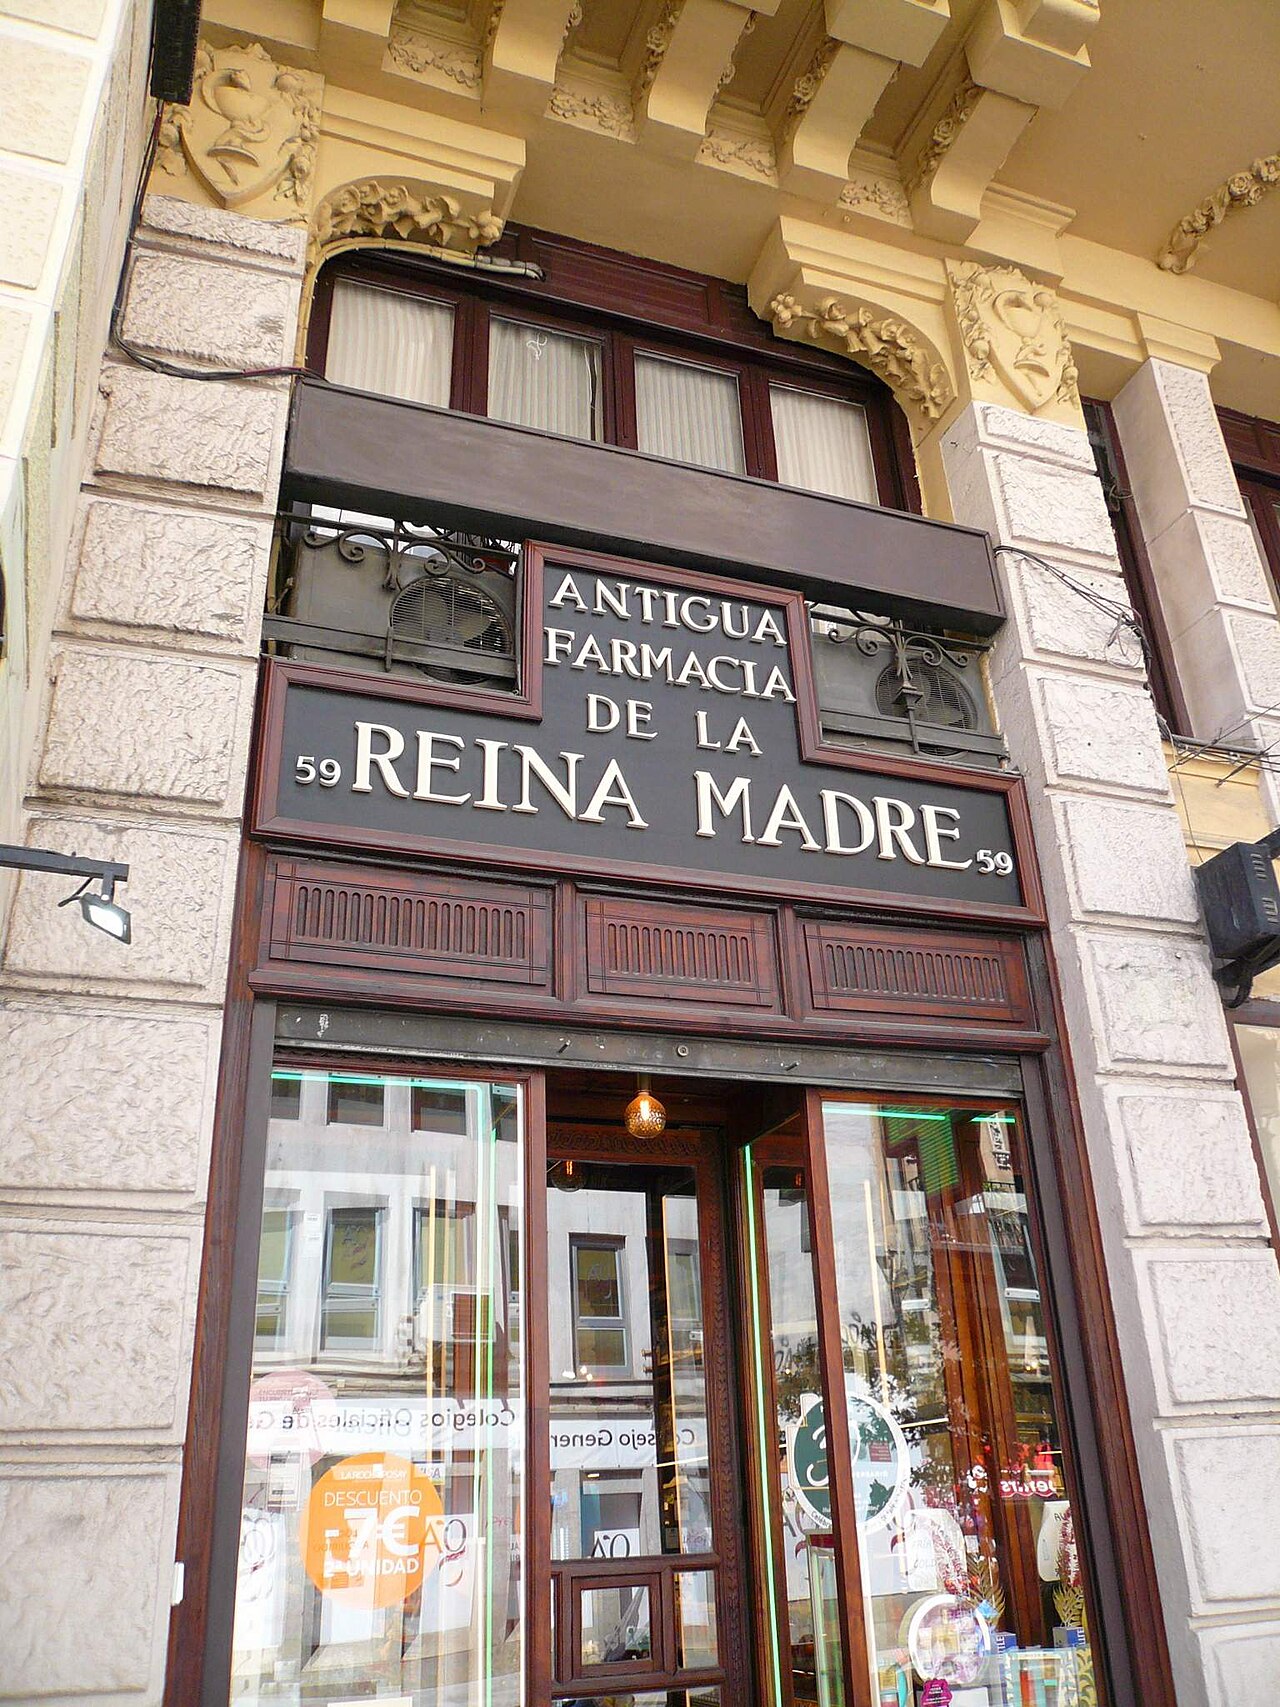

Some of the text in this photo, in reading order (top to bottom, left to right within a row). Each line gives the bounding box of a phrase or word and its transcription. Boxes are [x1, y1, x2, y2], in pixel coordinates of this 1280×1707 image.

[549, 573, 788, 647] ANTIGUA
[543, 626, 797, 703] FARMACIA
[586, 693, 763, 756] DE LA
[295, 721, 1015, 876] 59 REINA MADRE 59
[323, 1489, 423, 1507] DESCUENTO
[347, 1557, 420, 1576] UNIDAD
